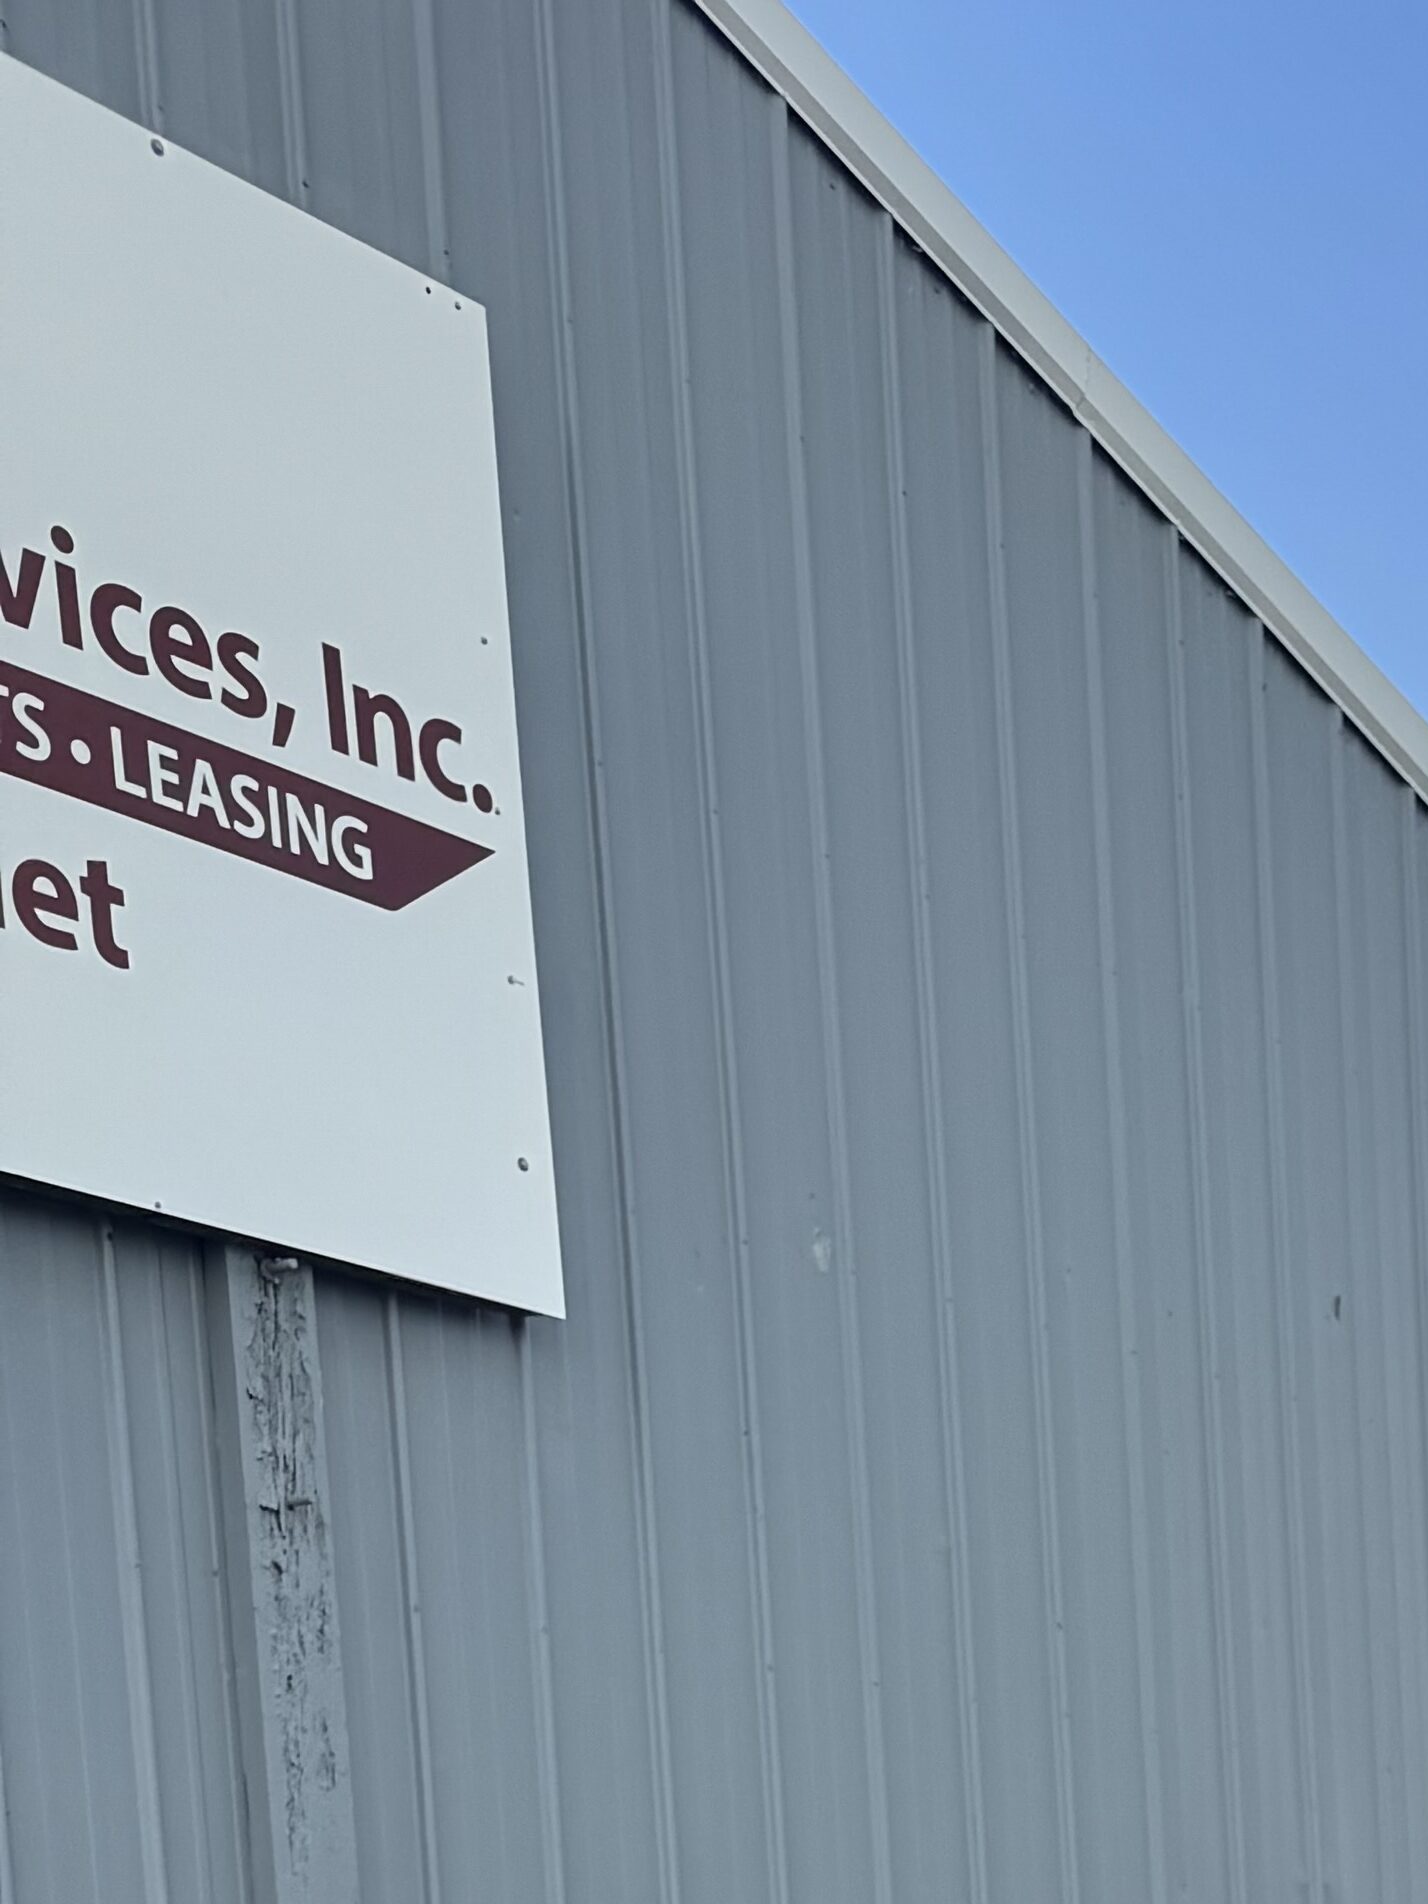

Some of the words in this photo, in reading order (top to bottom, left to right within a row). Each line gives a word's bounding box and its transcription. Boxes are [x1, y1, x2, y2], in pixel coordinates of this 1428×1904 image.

[0, 684, 51, 761] S
[110, 726, 374, 881] LEASING
[321, 642, 494, 815] Inc.
[0, 859, 130, 969] et
